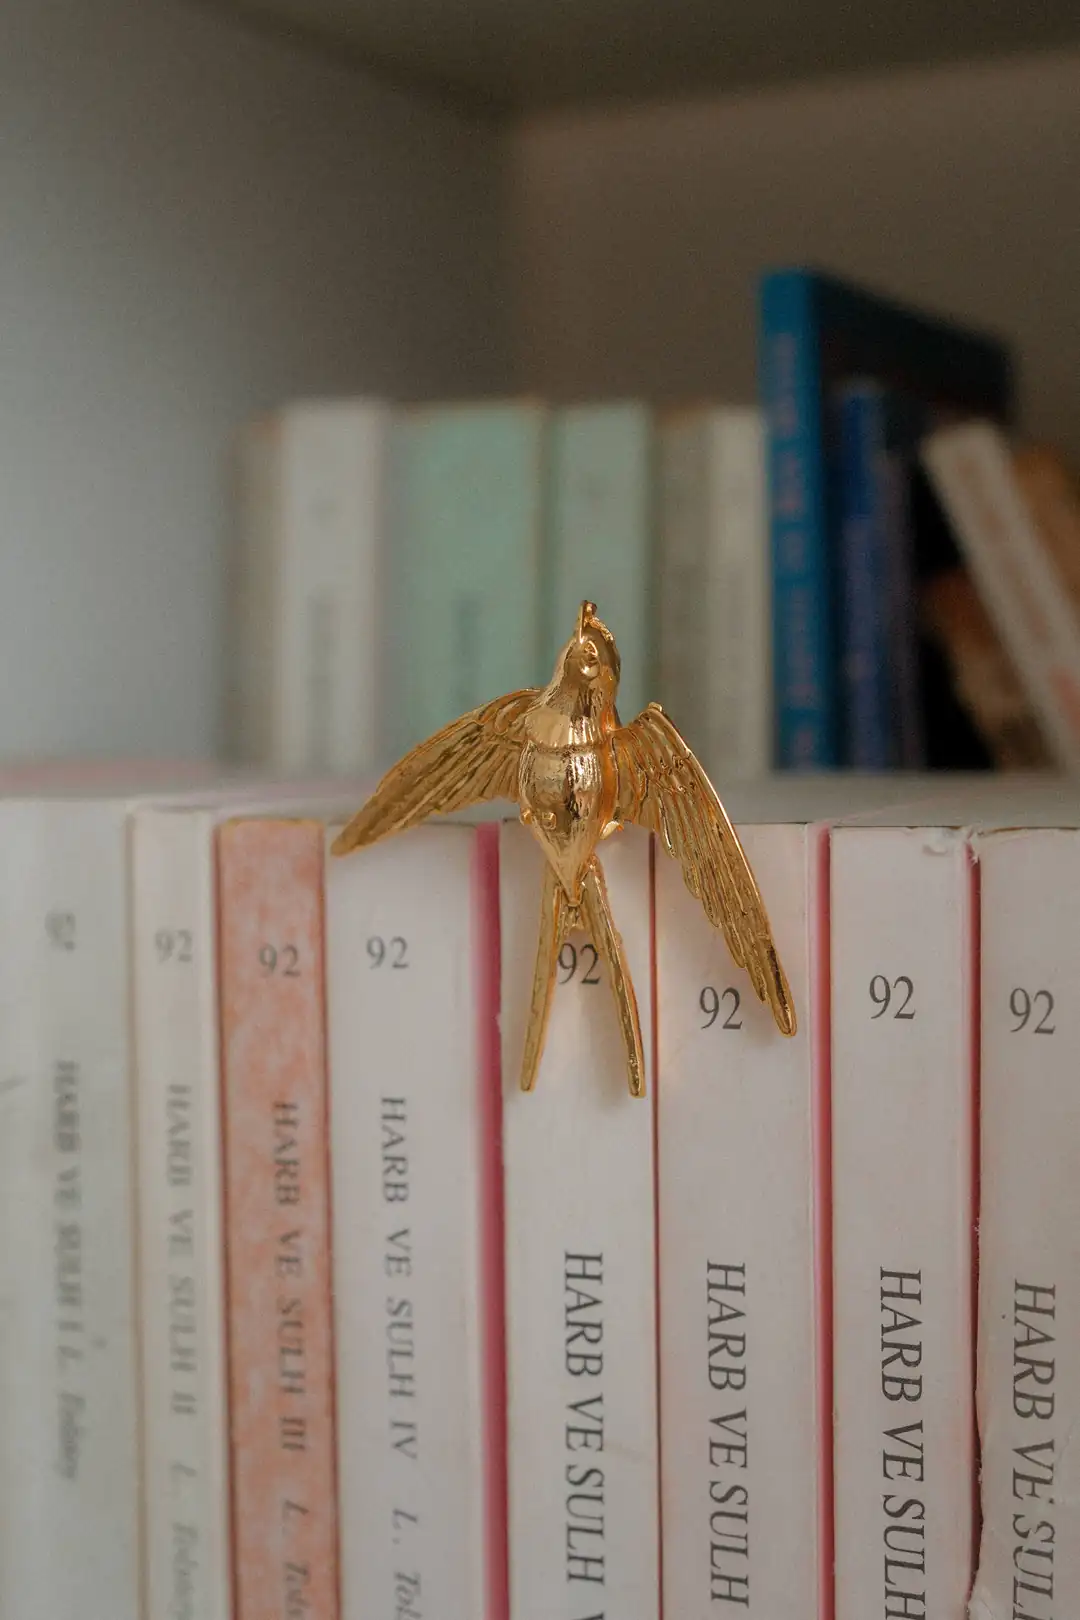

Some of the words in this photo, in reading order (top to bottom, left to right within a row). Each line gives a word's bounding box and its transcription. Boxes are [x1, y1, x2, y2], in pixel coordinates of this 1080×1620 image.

[154, 928, 194, 963] 92
[257, 941, 302, 978] 92
[365, 935, 410, 970] 92
[557, 942, 601, 985] 92
[699, 985, 744, 1030] 92
[867, 974, 916, 1020] 92
[1009, 987, 1057, 1035] 92
[272, 1100, 301, 1207] HARB
[379, 1096, 410, 1204] HARB
[275, 1229, 303, 1279] VE
[383, 1227, 413, 1278] VE
[564, 1250, 604, 1377] HARB
[706, 1258, 747, 1391] HARB
[879, 1265, 923, 1402] HARB
[275, 1296, 306, 1396] SULH
[385, 1296, 415, 1399] SULH
[1012, 1277, 1057, 1420] HARB
[279, 1415, 307, 1453] III
[390, 1420, 418, 1460] IV
[565, 1392, 604, 1452] VE
[709, 1405, 748, 1469] VE
[881, 1419, 925, 1482] VE
[1011, 1438, 1056, 1504] VE
[391, 1507, 419, 1545] L.
[566, 1463, 606, 1586] SULH
[709, 1480, 750, 1609] SULH
[881, 1494, 926, 1620] SULH
